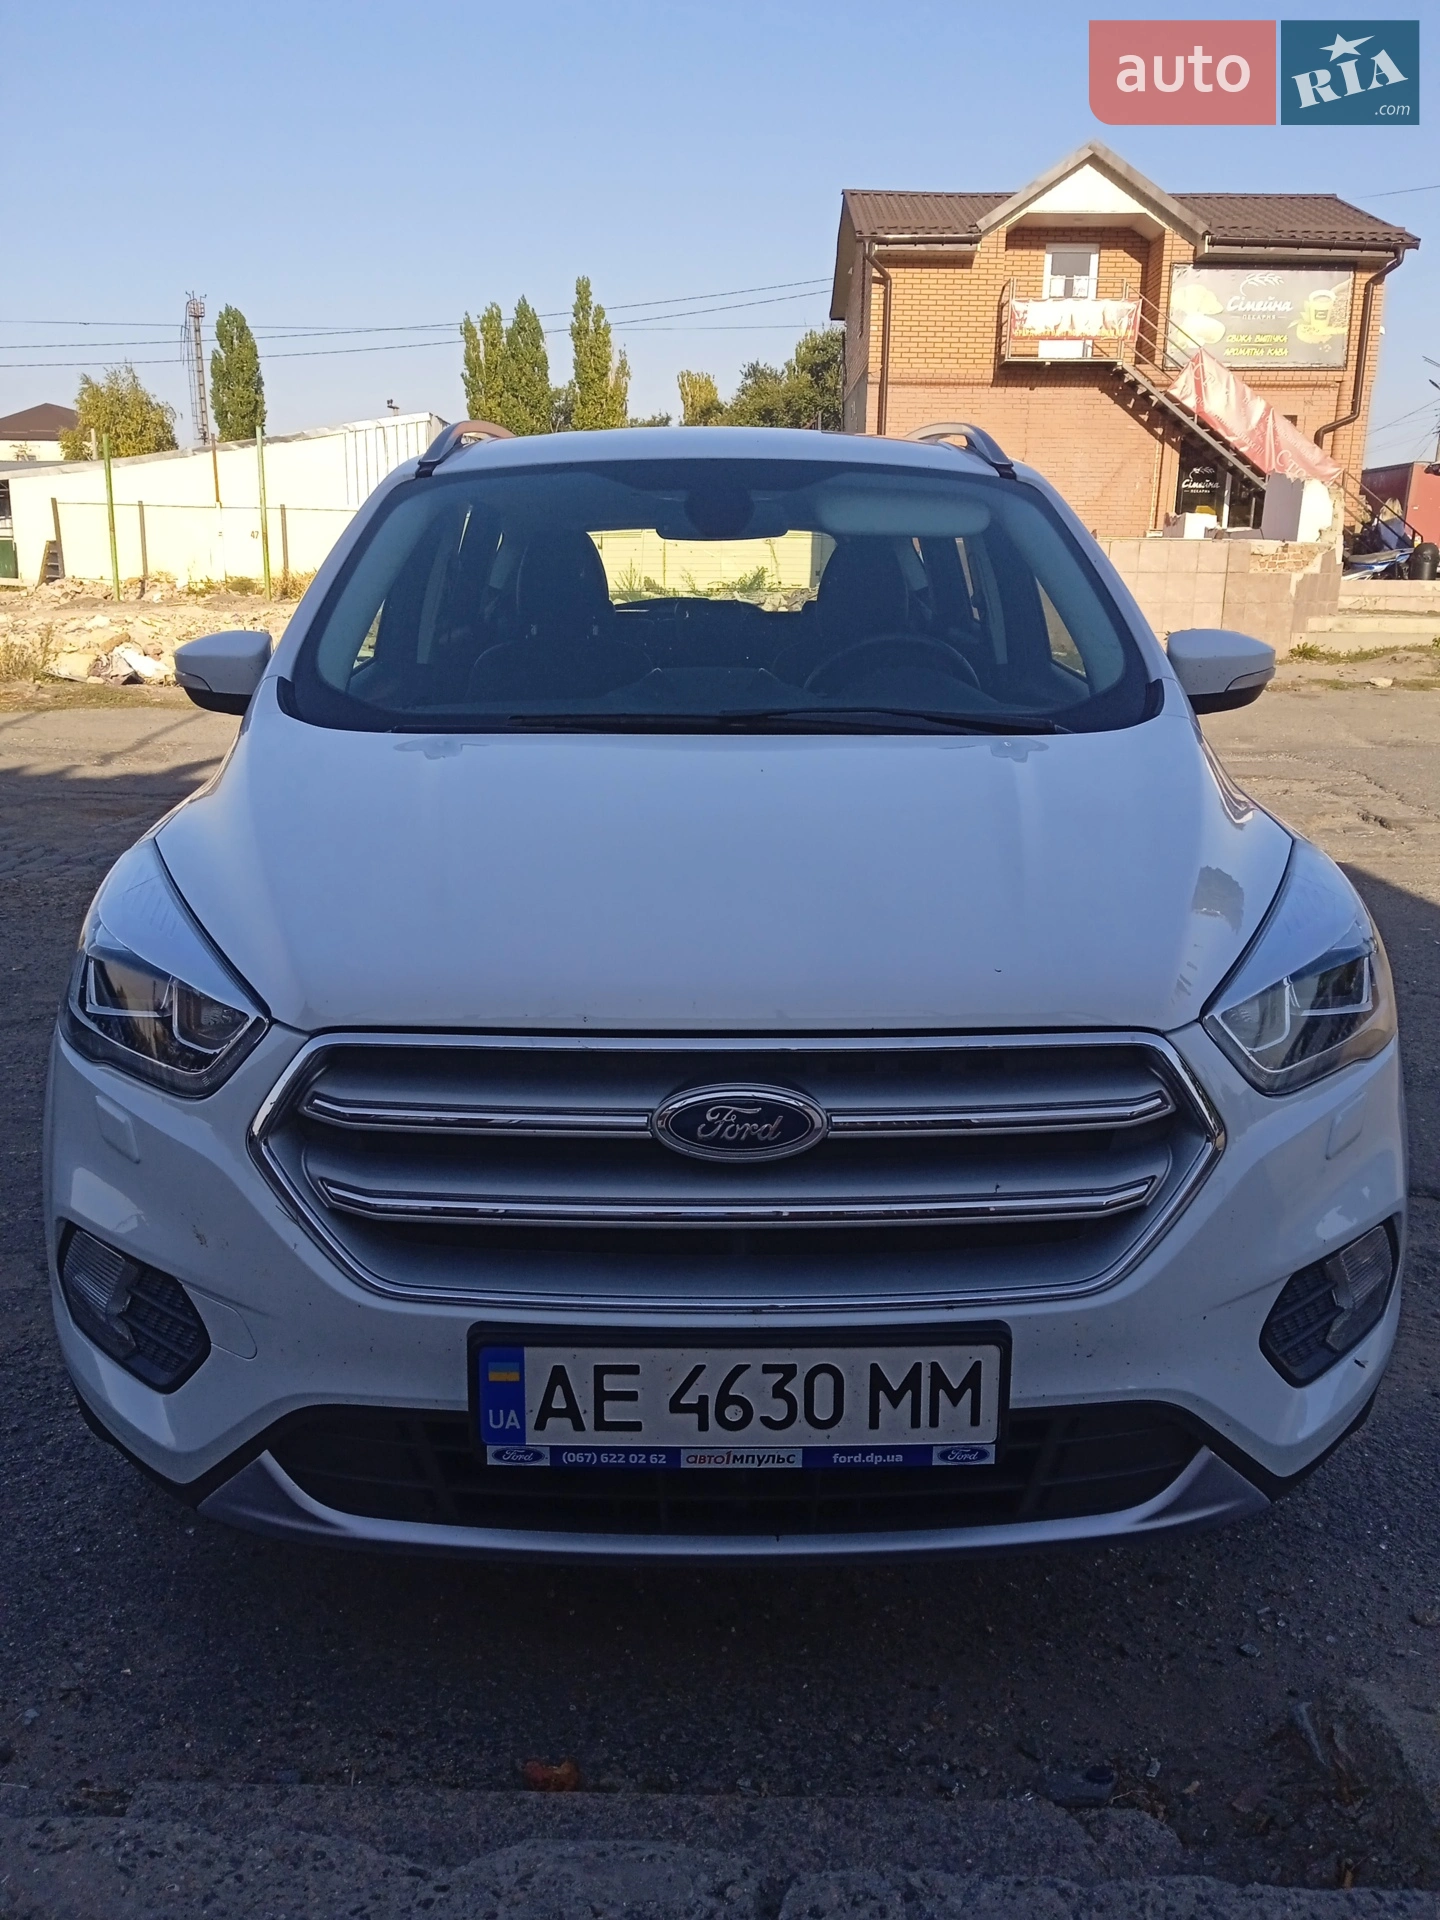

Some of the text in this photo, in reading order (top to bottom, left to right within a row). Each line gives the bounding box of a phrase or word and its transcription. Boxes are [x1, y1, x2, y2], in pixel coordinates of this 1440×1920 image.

[1266, 347, 1289, 356] КАВА
[697, 1105, 783, 1141] Ford
[533, 1360, 983, 1432] AE 4630 MM
[488, 1410, 520, 1430] UA
[502, 1450, 533, 1462] Ford
[562, 1452, 667, 1464] (067) 622 02 62
[832, 1453, 904, 1464] ford.dp.ua
[947, 1449, 978, 1461] Ford
